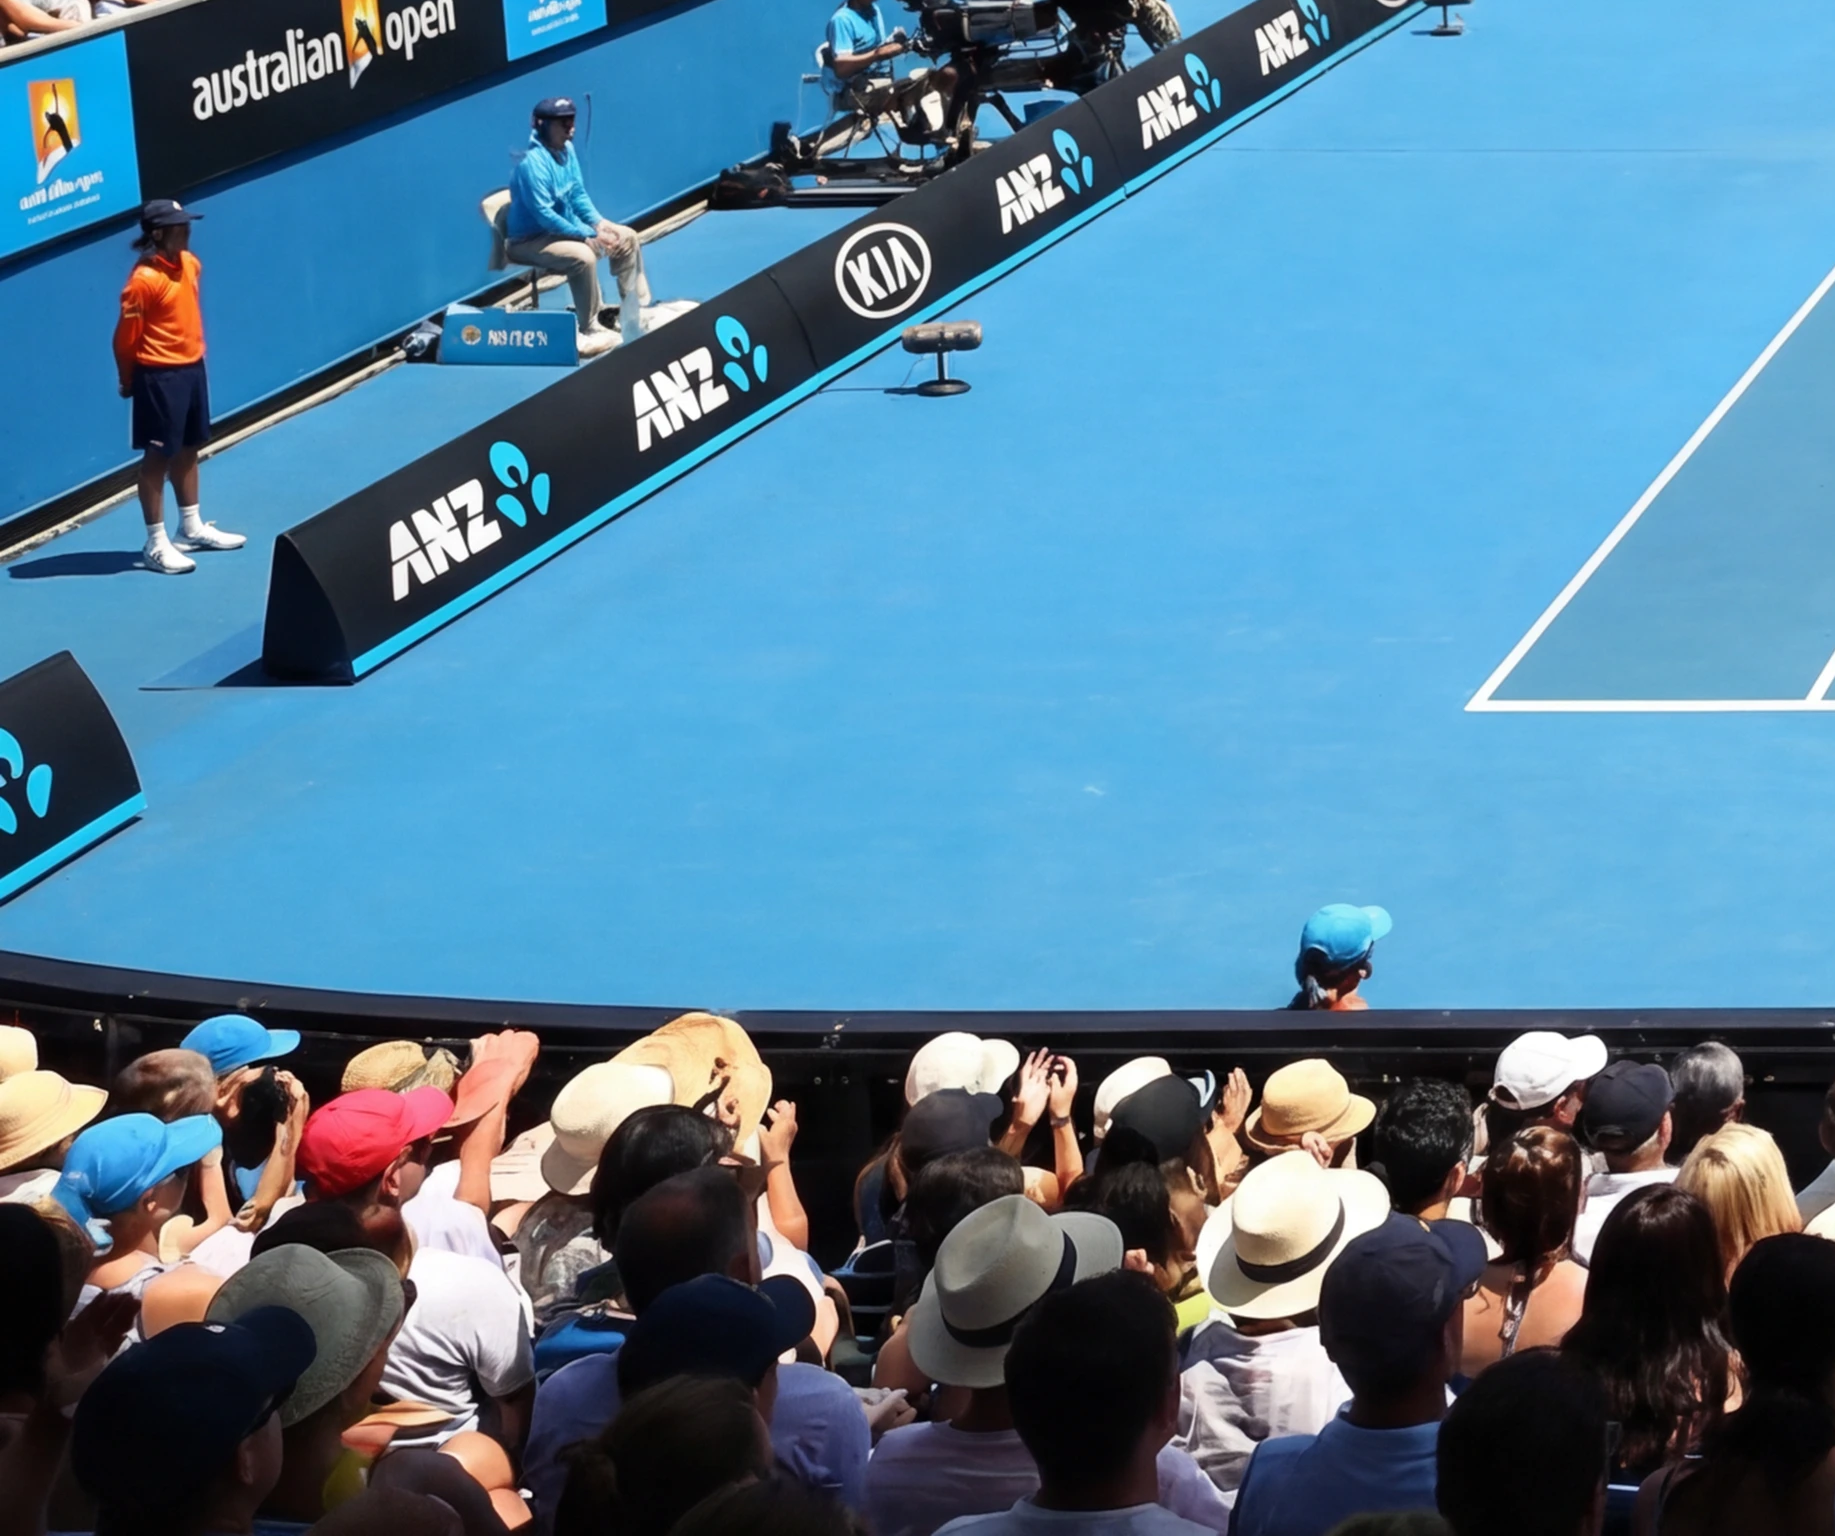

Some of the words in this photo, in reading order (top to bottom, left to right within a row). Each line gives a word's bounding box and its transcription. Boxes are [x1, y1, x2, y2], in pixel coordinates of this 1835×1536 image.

[192, 28, 343, 121] australian
[1254, 9, 1310, 76] ANZ
[1137, 75, 1198, 150] ANZ
[995, 153, 1065, 235] ANZ
[846, 237, 921, 307] KIA
[632, 346, 730, 452] ANZ
[389, 478, 503, 602] ANZ
